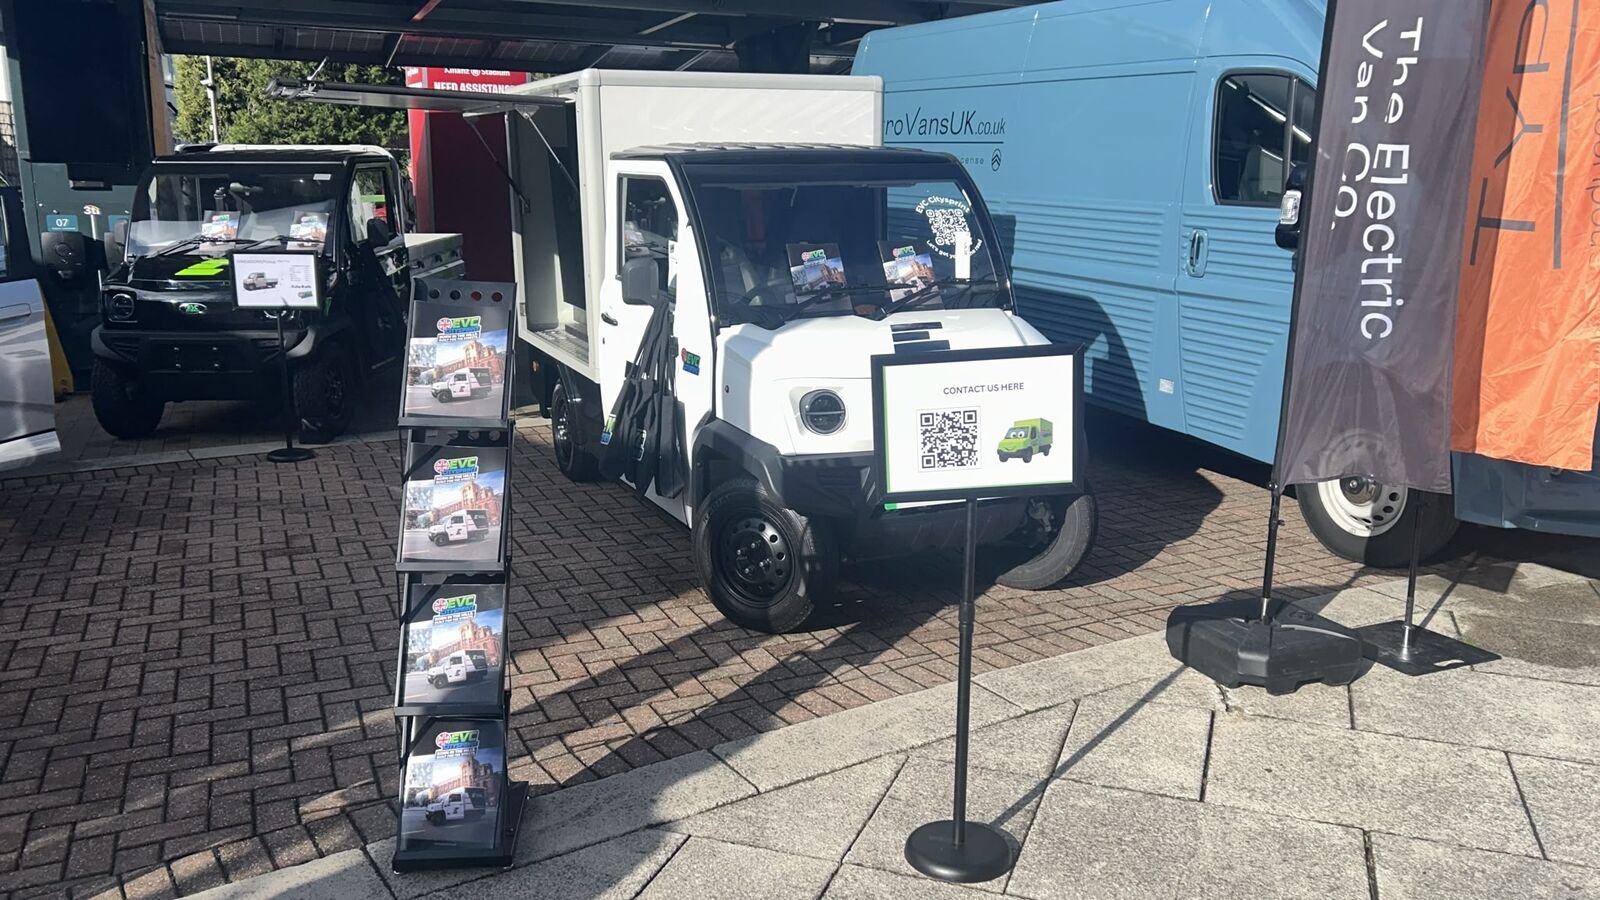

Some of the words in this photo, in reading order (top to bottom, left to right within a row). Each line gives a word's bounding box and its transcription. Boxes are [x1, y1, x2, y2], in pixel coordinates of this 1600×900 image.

[1351, 19, 1388, 124] Van
[1384, 16, 1423, 124] The
[459, 83, 513, 94] ASSISTANC
[1331, 142, 1370, 230] Co.
[915, 199, 929, 214] EVC
[927, 195, 970, 213] Citysprint
[55, 218, 69, 228] 07
[1361, 143, 1410, 339] Electric
[451, 317, 480, 329] EVC
[943, 385, 985, 395] CONTACT
[987, 384, 999, 392] US
[1001, 382, 1024, 391] HERE
[448, 458, 477, 470] EVC
[447, 595, 475, 609] EVC
[449, 730, 477, 744] EVC
